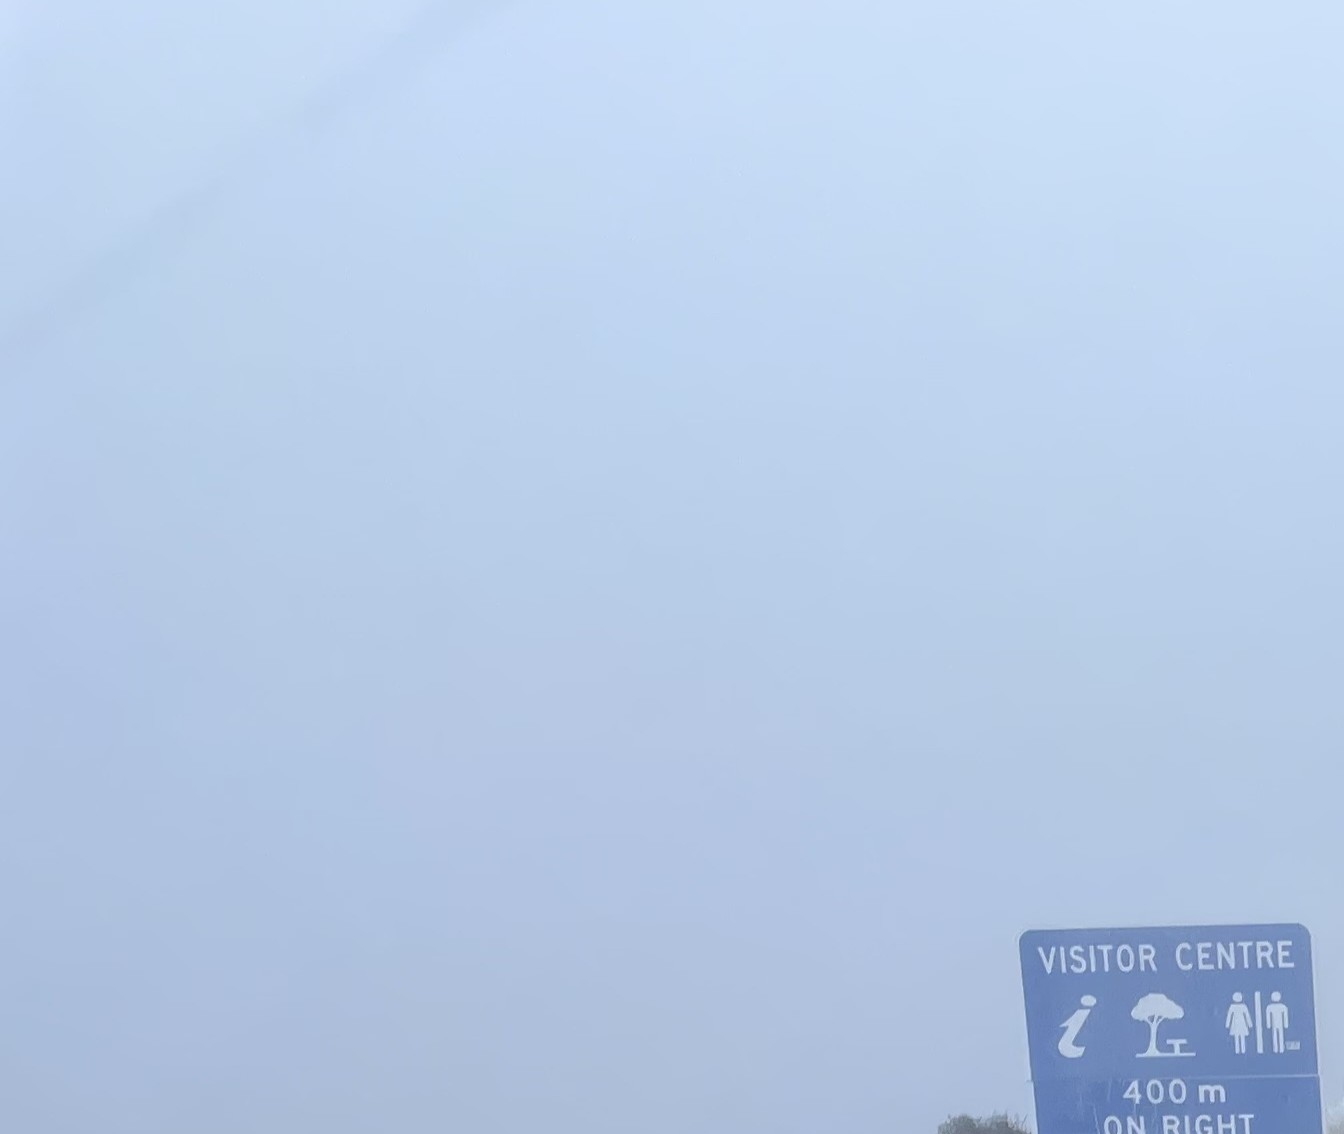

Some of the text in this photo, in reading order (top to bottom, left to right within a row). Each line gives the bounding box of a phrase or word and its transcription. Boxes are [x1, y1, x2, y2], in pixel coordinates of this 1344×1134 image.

[1037, 940, 1296, 975] VISITOR CENTRE
[1122, 1078, 1226, 1105] 400 m
